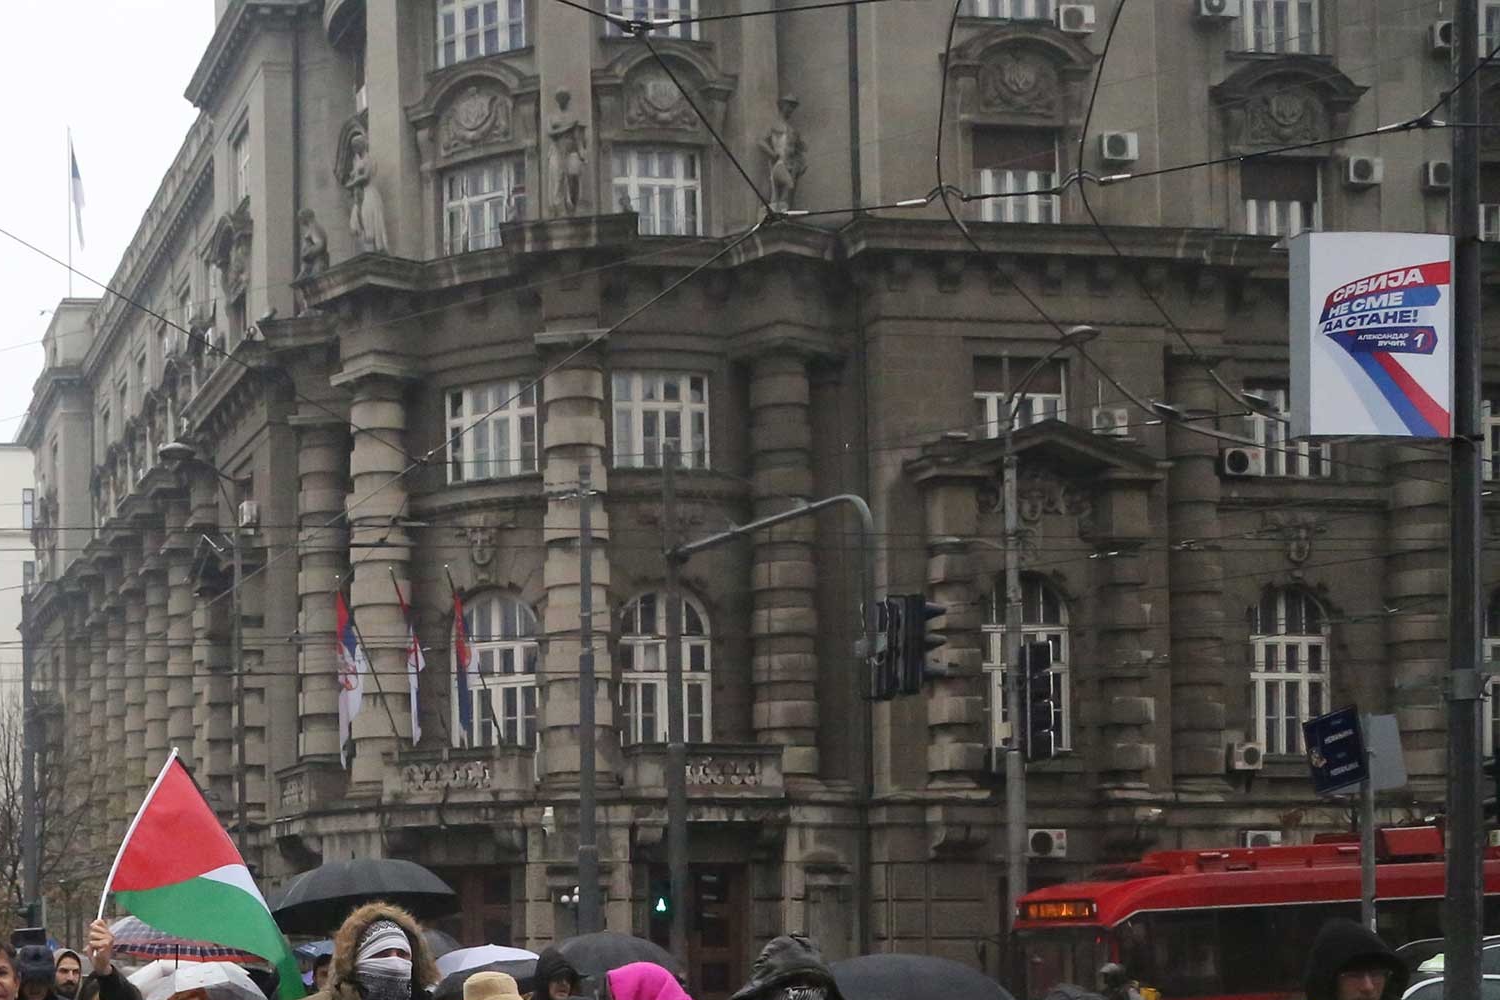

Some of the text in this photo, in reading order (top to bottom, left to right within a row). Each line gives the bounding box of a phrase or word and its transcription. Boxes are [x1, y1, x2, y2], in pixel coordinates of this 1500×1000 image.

[1333, 268, 1424, 302] СРБИЈА
[1328, 291, 1404, 318] НЕ СМЕ
[1323, 309, 1418, 333] ДА СТАНЕ!
[1414, 333, 1424, 347] 1
